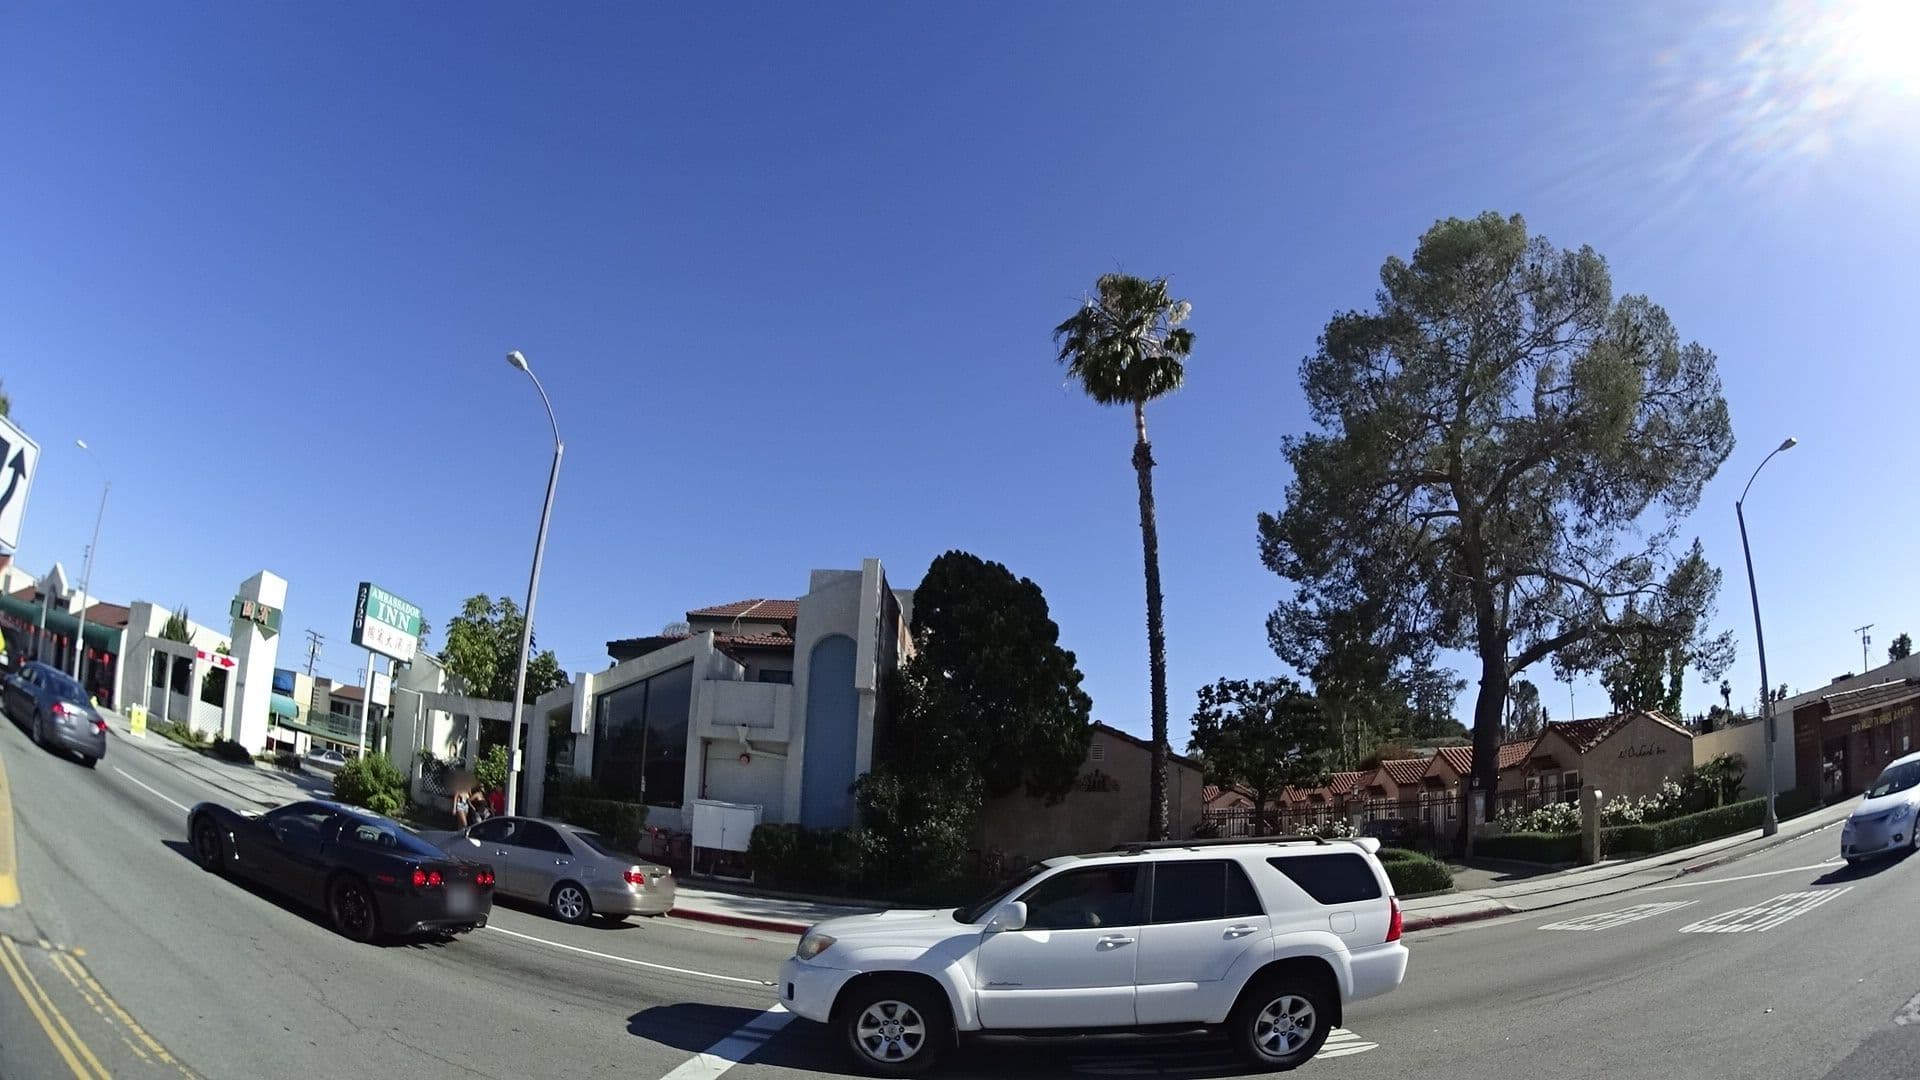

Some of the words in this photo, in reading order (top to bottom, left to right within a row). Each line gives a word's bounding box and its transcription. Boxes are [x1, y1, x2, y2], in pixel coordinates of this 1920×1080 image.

[371, 588, 420, 618] AMBASSADOR
[377, 602, 411, 632] INN
[1678, 886, 1856, 934] KEEP
